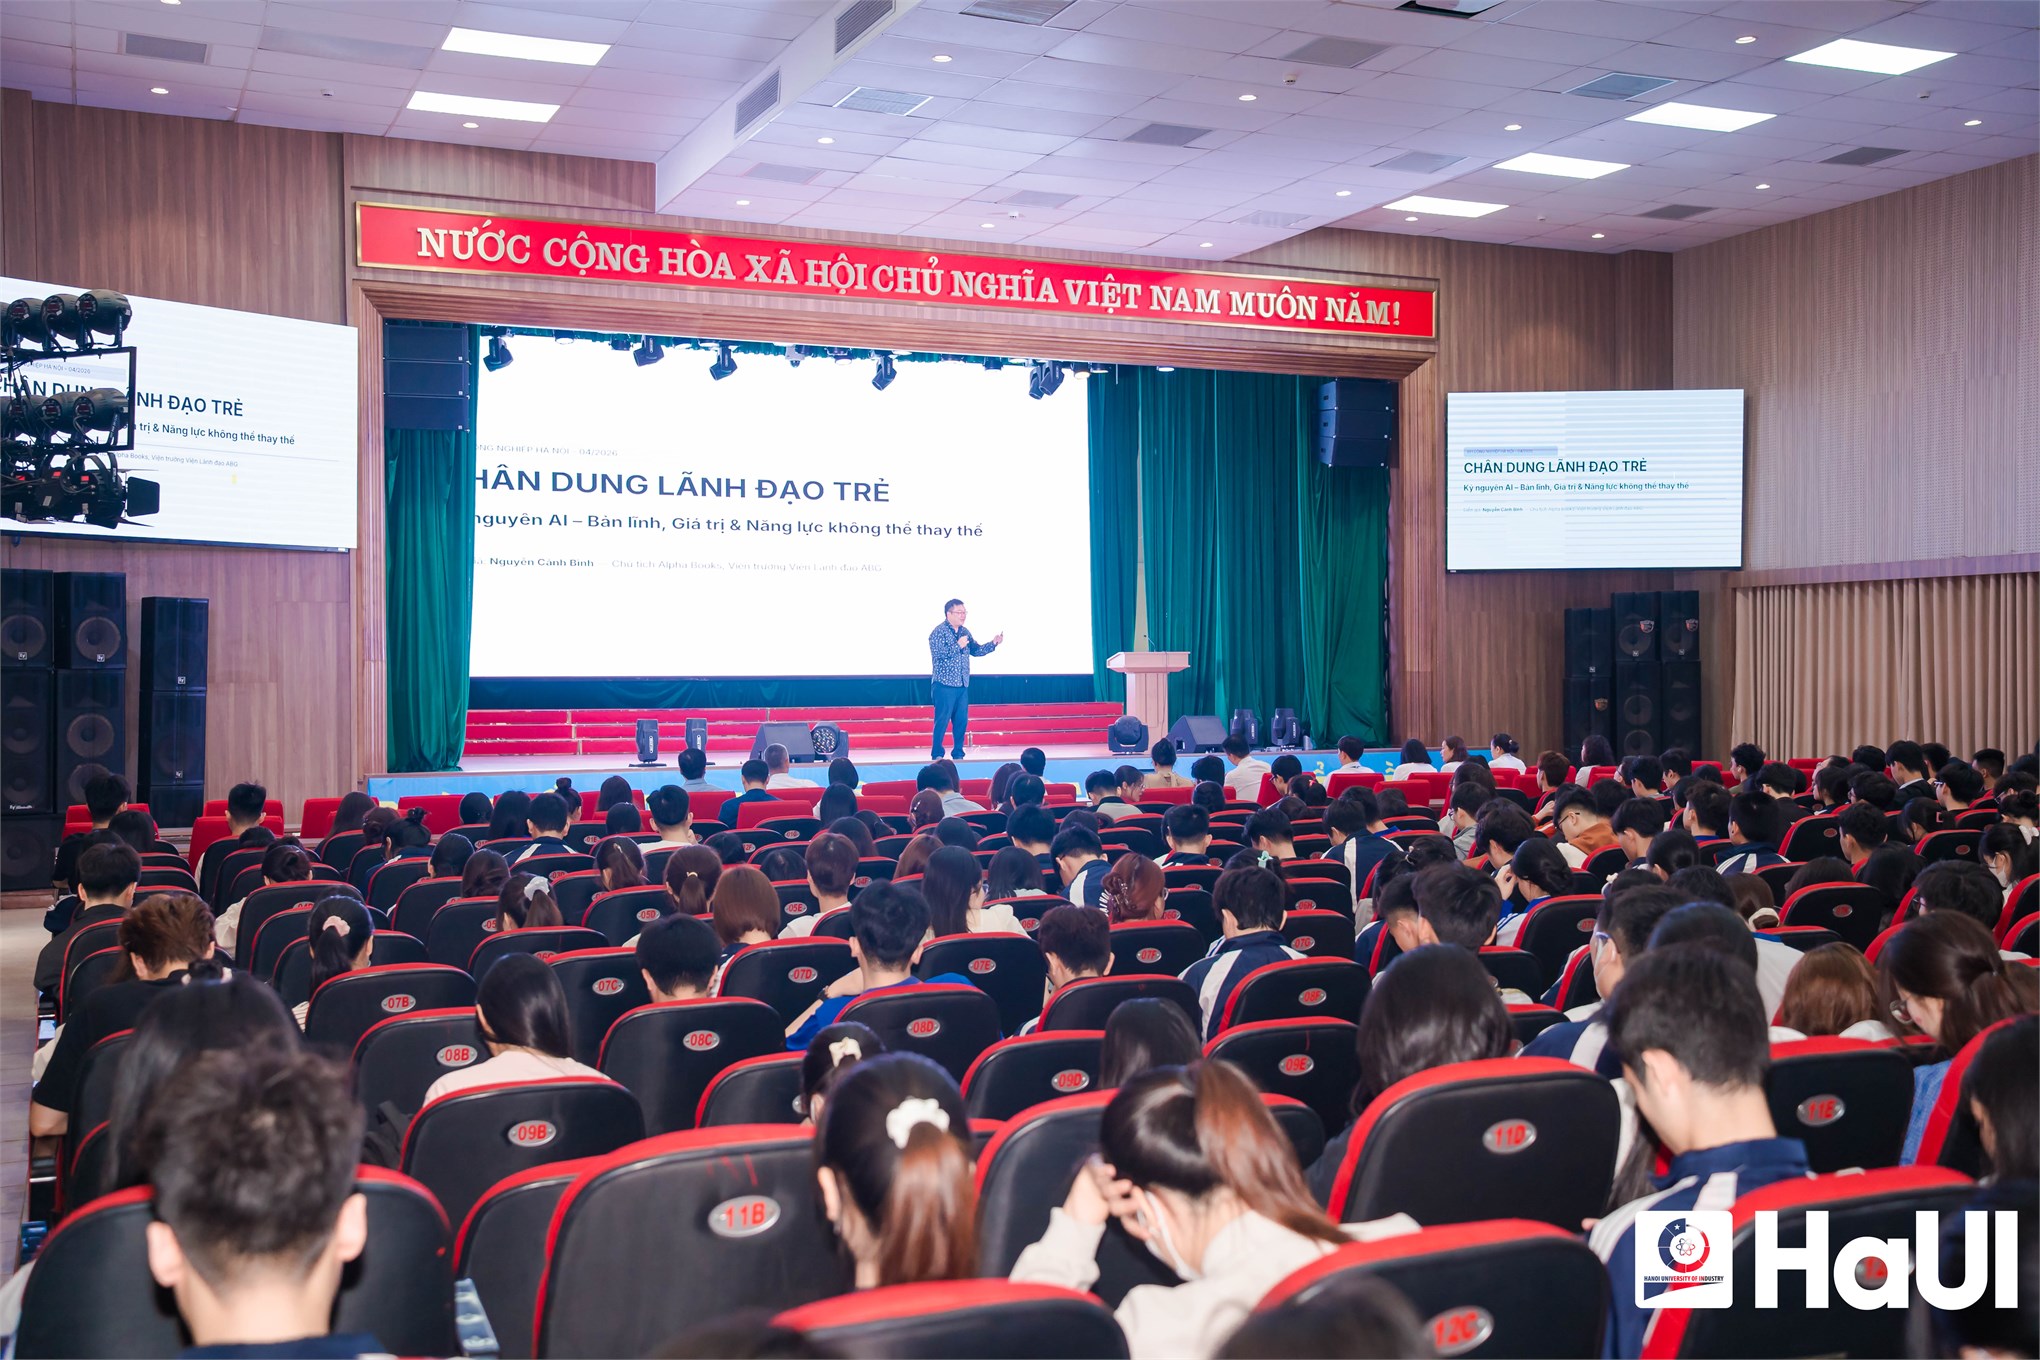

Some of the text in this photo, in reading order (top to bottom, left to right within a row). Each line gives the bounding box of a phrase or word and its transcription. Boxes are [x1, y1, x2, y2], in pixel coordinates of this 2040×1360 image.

[416, 219, 1401, 326] NƯỚC CỘNG HÒA XÃ HỘI CHỦ NGHĨA VIỆT NAM MUÔN NĂM!
[68, 366, 91, 374] 04/2026
[167, 395, 207, 415] ĐẠO
[211, 398, 243, 417] TRẺ
[139, 422, 295, 445] trị & Năng lực không thể thay thế
[130, 452, 150, 461] Books,
[579, 449, 618, 457] 04/2026
[1464, 457, 1647, 475] CHÂN DUNG LÃNH ĐẠO TRẺ
[475, 464, 890, 505] HÂN DUNG LÃNH ĐẠO TRẺ
[1475, 484, 1504, 493] nguyên
[1619, 482, 1643, 492] không
[1658, 482, 1676, 491] thay
[549, 515, 568, 526] AI
[588, 514, 622, 528] Bản
[628, 516, 666, 532] lĩnh,
[672, 516, 701, 531] Giá
[706, 518, 725, 534] trị
[730, 519, 742, 531] &
[747, 519, 792, 535] Năng
[797, 520, 823, 536] lực
[828, 522, 881, 538] không
[885, 520, 912, 535] thể
[916, 524, 952, 539] thay
[957, 522, 983, 537] thế
[641, 910, 656, 919] 05D
[788, 904, 803, 912] 05E
[486, 920, 496, 929] 05
[1021, 919, 1035, 929] 06F
[1295, 938, 1311, 948] 07G
[1141, 949, 1157, 960] 07F
[973, 960, 991, 970] 07E
[793, 969, 812, 980] 07D
[597, 980, 618, 991] 07C
[387, 996, 409, 1008] 07B
[1303, 991, 1321, 1002] 08F
[912, 1020, 933, 1034] 08D
[689, 1033, 712, 1046] 08C
[444, 1048, 469, 1061] 08B
[1285, 1057, 1306, 1071] 09E
[1058, 1072, 1082, 1088] 09D
[1808, 1099, 1837, 1121] 11E
[517, 1124, 547, 1141] 09B
[1495, 1123, 1527, 1147] 11D
[725, 1201, 765, 1228] 11B
[1434, 1311, 1478, 1348] 12C
